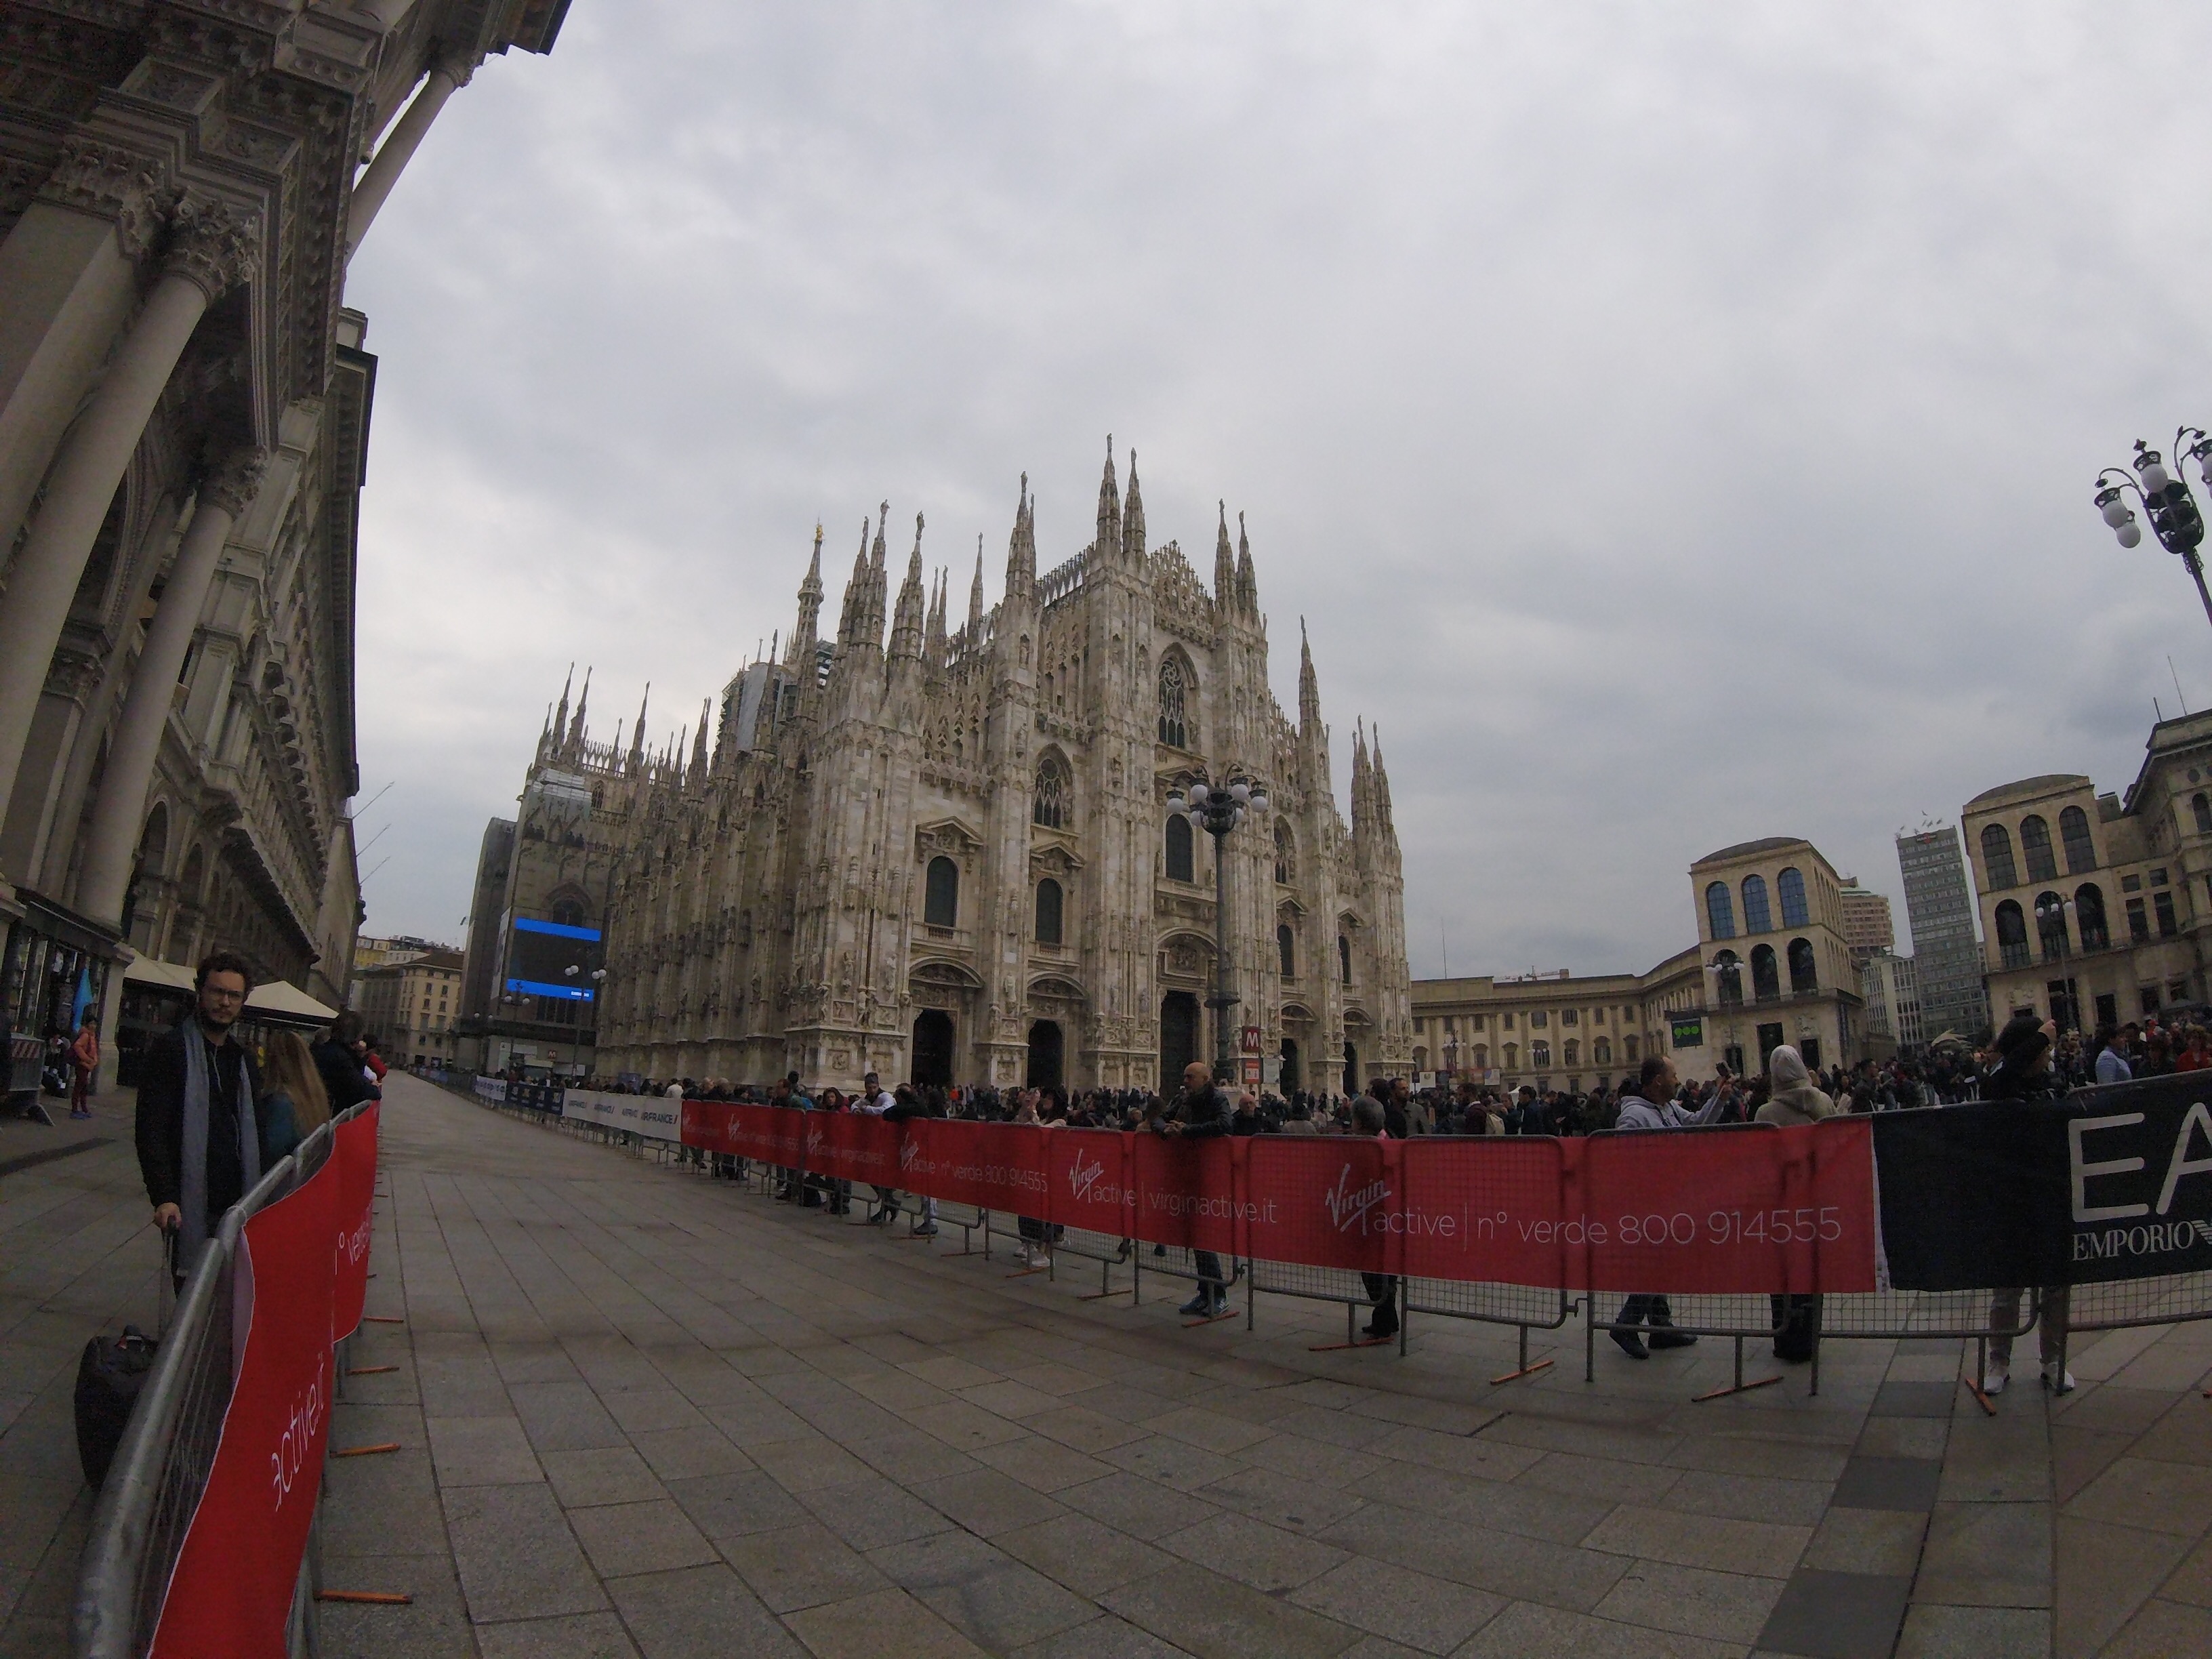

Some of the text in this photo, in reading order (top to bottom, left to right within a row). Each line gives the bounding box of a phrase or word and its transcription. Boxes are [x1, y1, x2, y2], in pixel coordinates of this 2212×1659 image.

[1246, 1031, 1258, 1047] M
[952, 1164, 983, 1181] verde
[985, 1164, 1007, 1185] 800
[1069, 1148, 1104, 1204] Virgin
[1094, 1184, 1277, 1223] active virginactive.it
[1325, 1163, 1392, 1235] Virgin
[1374, 1207, 1456, 1237] active
[1518, 1214, 1607, 1244] verde
[1619, 1213, 1696, 1244] 800
[1708, 1207, 1842, 1244] 914555
[2071, 1221, 2194, 1261] EMPORIO
